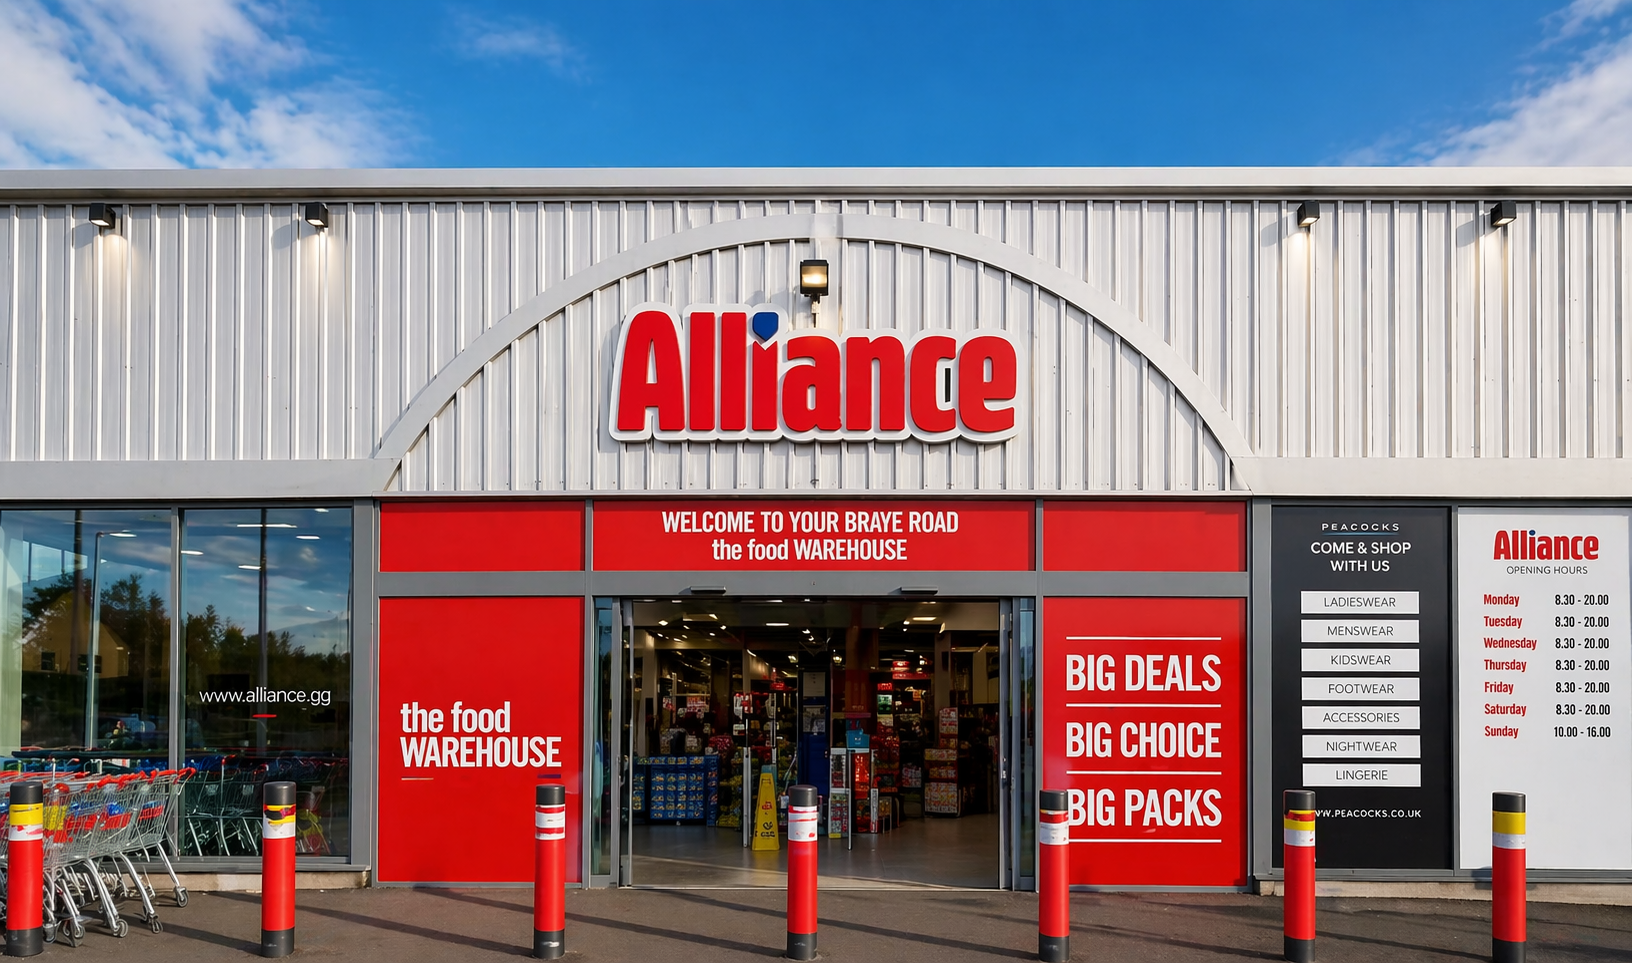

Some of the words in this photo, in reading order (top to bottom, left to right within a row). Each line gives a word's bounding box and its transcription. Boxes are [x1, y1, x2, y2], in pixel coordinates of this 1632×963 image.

[618, 311, 1016, 432] Alliance
[662, 511, 754, 532] WELCOME
[761, 511, 783, 532] TO
[789, 511, 838, 532] YOUR
[845, 512, 903, 532] BRAYE
[909, 512, 958, 532] ROAD
[1322, 523, 1399, 531] PEACOCKS
[712, 539, 742, 560] the
[747, 539, 788, 560] food
[794, 539, 907, 560] WAREHOUSE
[1311, 542, 1354, 554] COME
[1358, 542, 1367, 554] &
[1371, 542, 1411, 554] SHOP
[1494, 530, 1599, 560] Alliance
[1330, 560, 1367, 571] WITH
[1372, 560, 1389, 571] US
[1507, 566, 1550, 574] OPENING
[1554, 566, 1587, 574] HOURS
[1324, 597, 1395, 607] LADIESWEAR
[1484, 594, 1519, 607] Monday
[1555, 594, 1575, 605] 8.30
[1584, 595, 1608, 605] 20.00
[1484, 616, 1522, 628] Tuesday
[1555, 616, 1575, 627] 8.30
[1584, 616, 1609, 627] 20.00
[1328, 626, 1393, 636] MENSWEAR
[1484, 638, 1537, 650] Wednesday
[1555, 638, 1575, 649] 8.30
[1584, 638, 1609, 649] 20.00
[1331, 655, 1390, 665] KIDSWEAR
[1484, 659, 1527, 672] Thursday
[1556, 660, 1575, 670] 8.30
[1585, 660, 1609, 670] 20.00
[1067, 655, 1115, 691] BIG
[1126, 655, 1221, 691] DEALS
[1329, 684, 1394, 693] FOOTWEAR
[1485, 682, 1513, 694] Friday
[1556, 682, 1575, 693] 8.30
[1585, 682, 1609, 693] 20.00
[200, 687, 330, 705] www.alliance.gg
[1485, 703, 1526, 716] Saturday
[1556, 704, 1575, 715] 8.30
[1585, 704, 1610, 715] 20.00
[401, 702, 443, 732] the
[451, 701, 510, 733] food
[1323, 713, 1399, 722] ACCESSORIES
[1485, 726, 1518, 738] Sunday
[1554, 727, 1577, 737] 10.00
[1587, 726, 1611, 737] 16.00
[1067, 722, 1111, 757] BIG
[1121, 722, 1221, 757] CHOICE
[400, 737, 561, 767] WAREHOUSE
[1327, 742, 1397, 751] NIGHTWEAR
[1336, 770, 1387, 780] LINGERIE
[1068, 789, 1115, 826] BIG
[1125, 789, 1221, 826] PACKS
